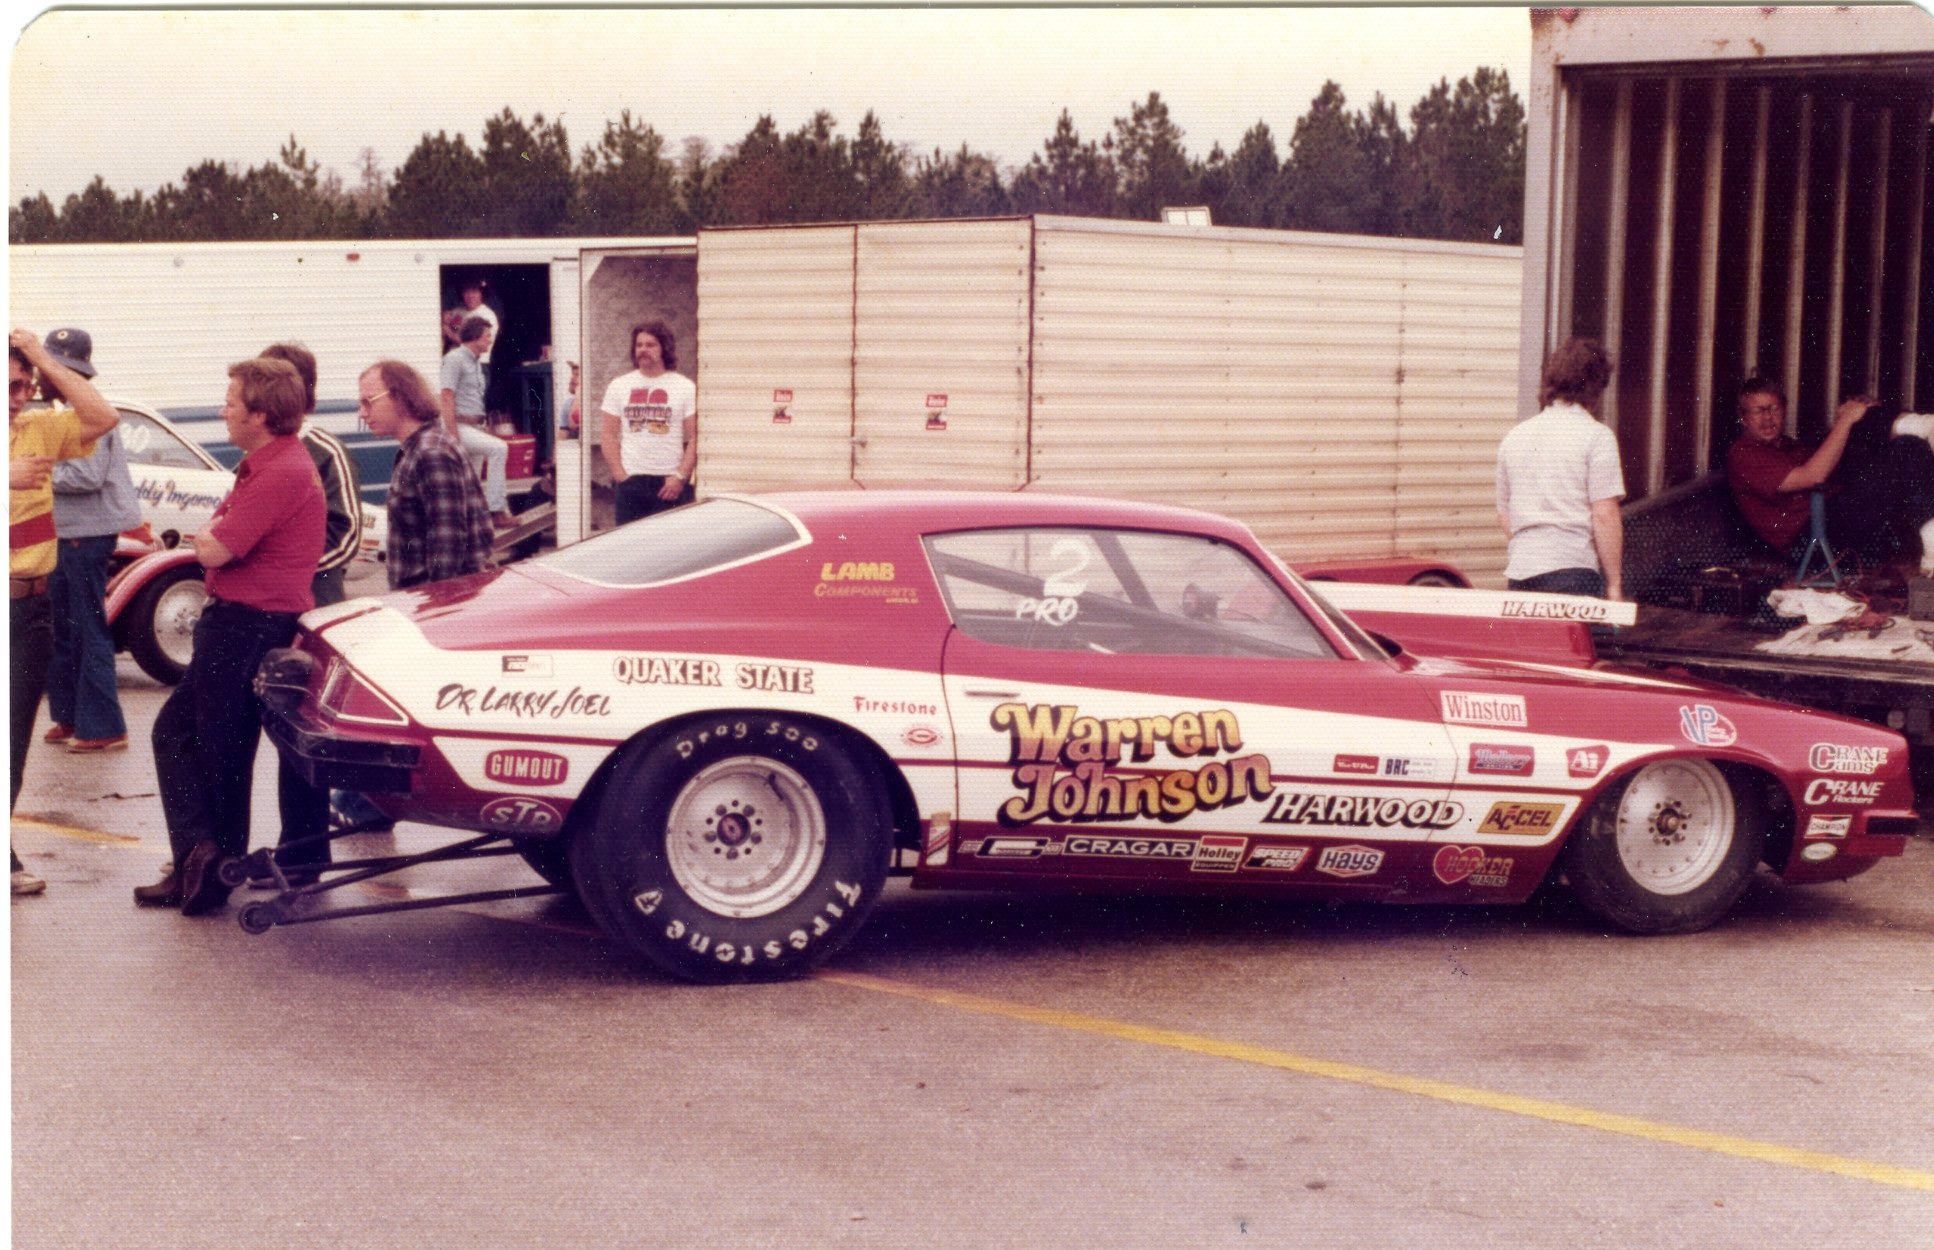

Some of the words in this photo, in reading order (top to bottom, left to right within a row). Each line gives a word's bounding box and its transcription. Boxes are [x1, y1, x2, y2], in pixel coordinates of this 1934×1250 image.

[821, 562, 895, 581] LAMB
[1043, 539, 1090, 597] 2
[1016, 597, 1078, 626] PRO
[1501, 600, 1608, 620] HARWOOD
[613, 656, 722, 687] QUAKER
[735, 663, 814, 694] STATE
[480, 686, 557, 718] LARRY
[550, 686, 610, 719] JOEL
[853, 696, 937, 715] Firestone
[1446, 694, 1523, 722] Winston
[989, 702, 1244, 766] Warren
[1679, 704, 1718, 745] VP
[677, 721, 748, 759] Drag
[766, 721, 818, 752] 500
[491, 753, 562, 780] GUMOUT
[997, 753, 1276, 828] Johnson
[1804, 778, 1885, 806] CRANE
[491, 801, 552, 827] STP
[1260, 792, 1465, 829] HARWOOD
[1487, 808, 1552, 830] ACCEL
[1069, 839, 1193, 857] CRAGAR
[1200, 847, 1241, 860] Holley
[1252, 848, 1303, 858] SPEED
[1261, 858, 1296, 868] PRO
[665, 880, 863, 965] Firestone
